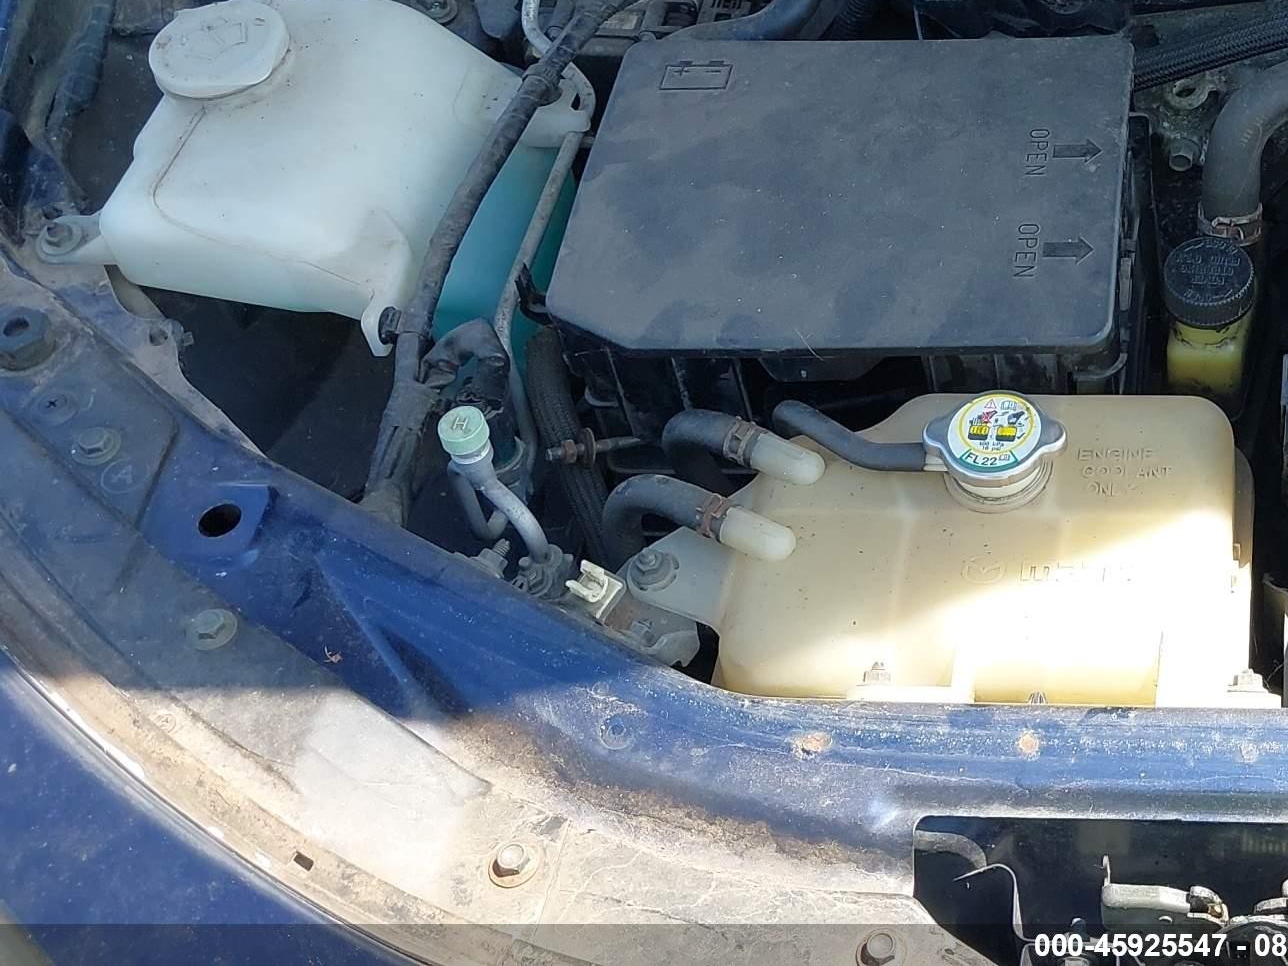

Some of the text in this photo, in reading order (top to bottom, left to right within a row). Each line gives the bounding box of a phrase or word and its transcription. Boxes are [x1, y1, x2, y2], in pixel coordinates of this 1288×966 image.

[1025, 128, 1051, 177] OPEN
[1012, 222, 1040, 279] OPEN
[452, 417, 469, 430] H
[964, 452, 998, 466] FL22
[1077, 448, 1154, 460] ENGINE
